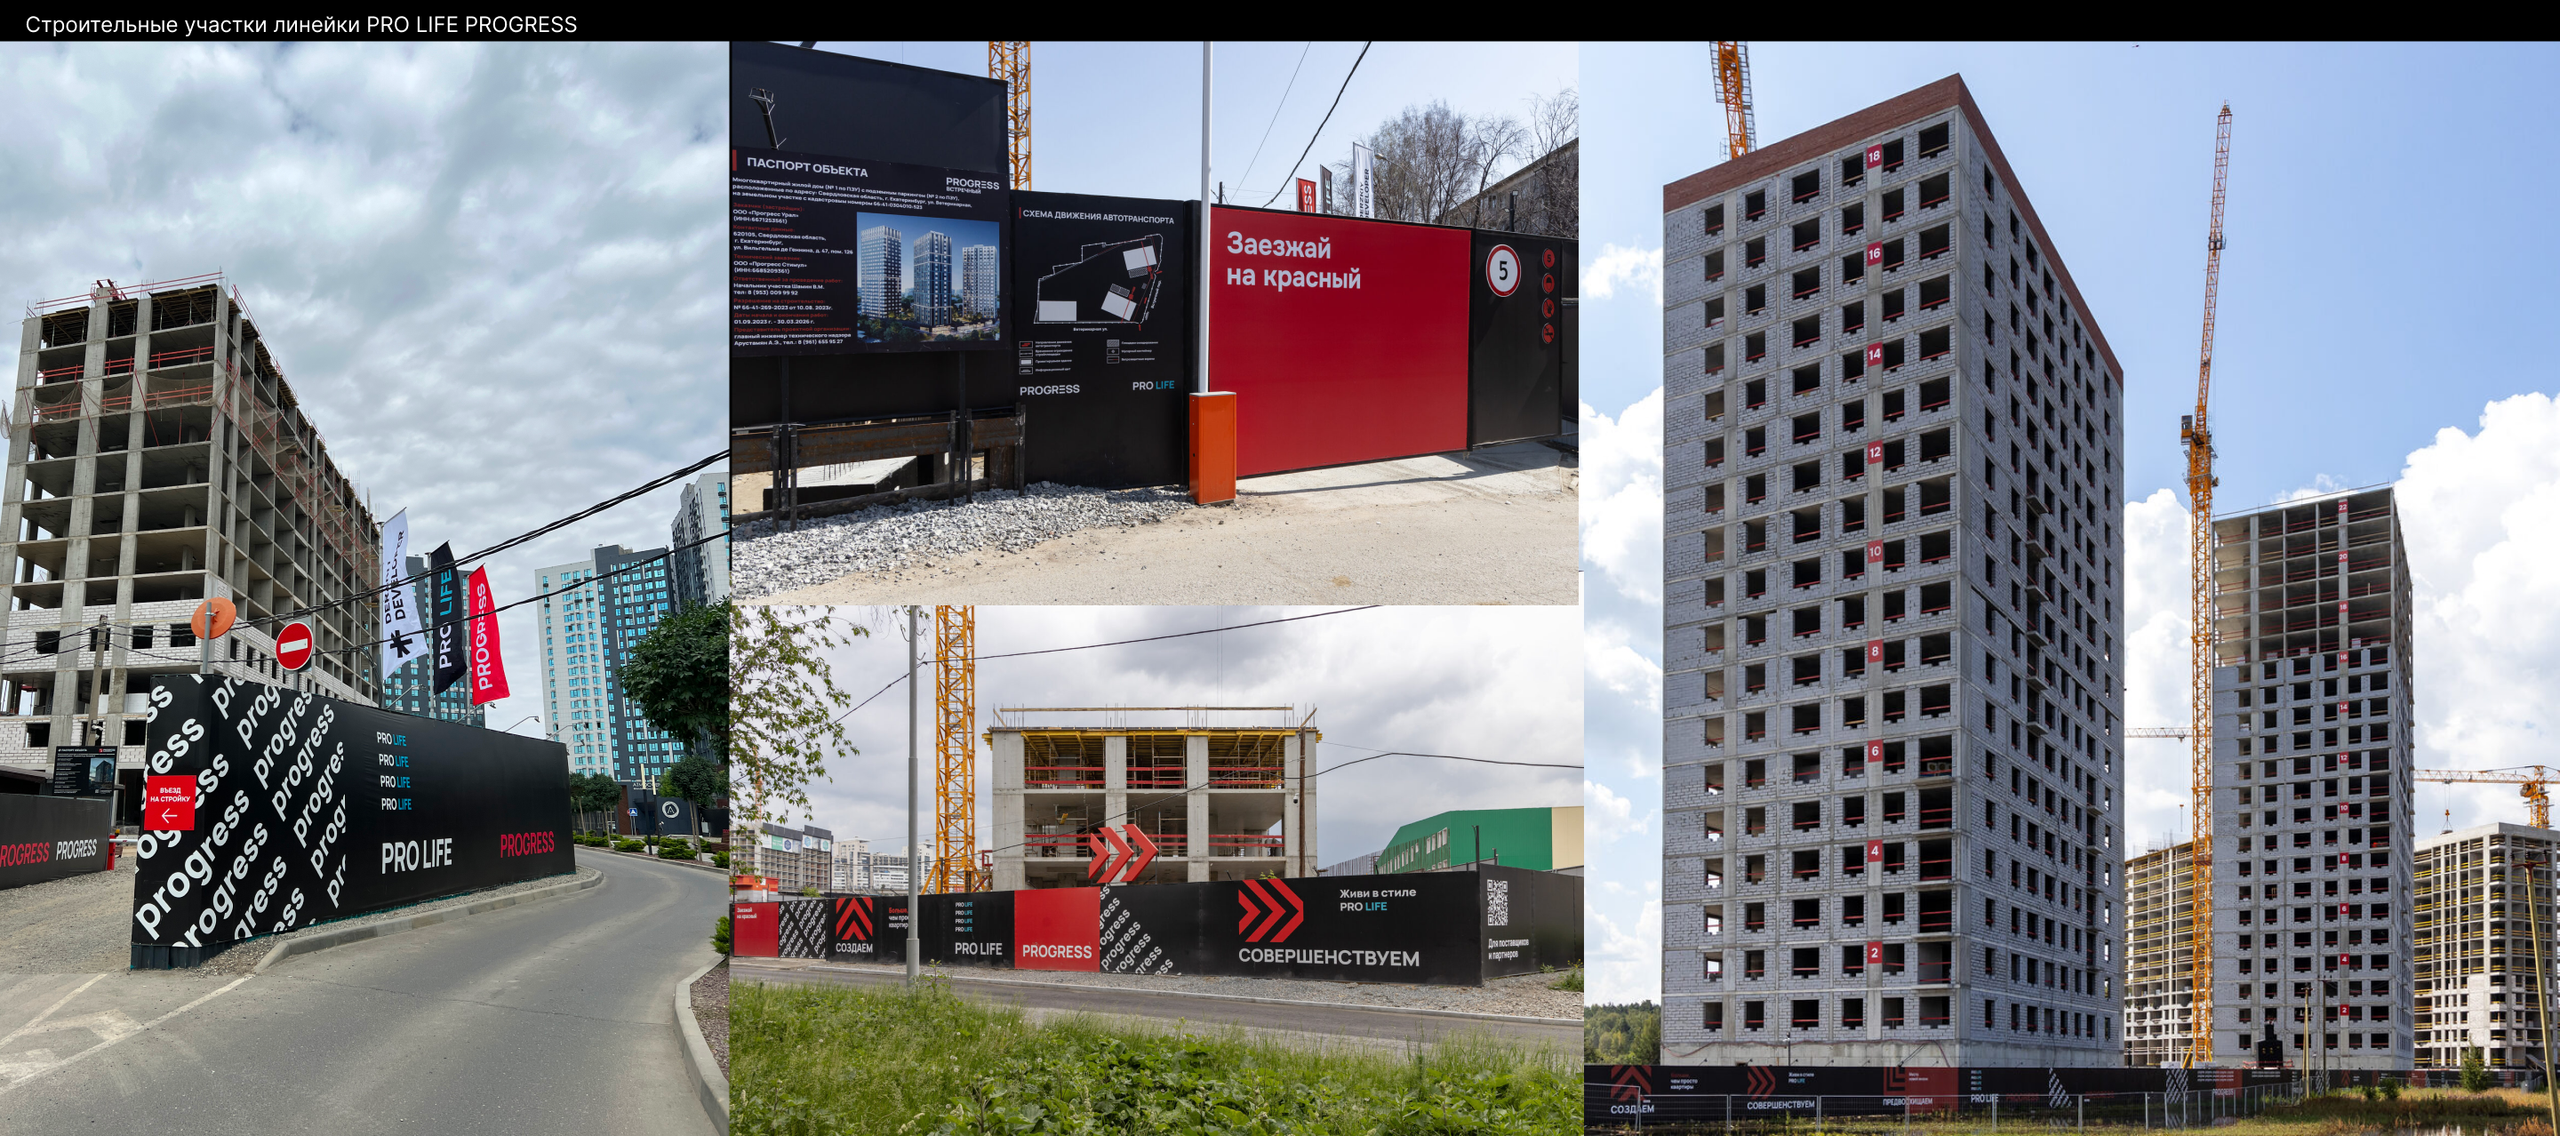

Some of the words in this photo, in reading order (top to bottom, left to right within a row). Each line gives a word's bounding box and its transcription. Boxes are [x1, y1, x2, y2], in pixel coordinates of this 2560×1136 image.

[1869, 150, 1880, 162] 18
[747, 157, 811, 172] ПАСПОРТ
[812, 163, 868, 178] ОБЪЕКТА
[732, 177, 791, 188] Многоквартирный
[946, 177, 1000, 190] PROGRESS
[818, 190, 859, 199] Свердловская
[946, 186, 981, 195] ВСТРЕЧНЫЙ
[748, 210, 781, 218] «Прогресс
[1023, 209, 1053, 219] СХЕМА
[1054, 210, 1101, 221] ДВИЖЕНИЯ
[1102, 213, 1174, 225] АВТОТРАНСПОРТА
[758, 232, 801, 240] Свердловская
[1227, 231, 1331, 259] Заезжай
[1869, 248, 1880, 259] 16
[1499, 261, 1508, 281] 5
[1227, 267, 1256, 286] на
[1263, 267, 1361, 292] красный
[1869, 349, 1881, 360] 14
[1020, 384, 1080, 396] PROGRESS
[1132, 381, 1153, 391] PRO
[1155, 380, 1175, 390] LIFE
[1870, 447, 1880, 458] 12
[1870, 546, 1881, 557] 10
[440, 569, 452, 616] LIFE
[1871, 646, 1879, 657] 8
[377, 731, 392, 745] PRO
[393, 733, 407, 747] LIFE
[1871, 746, 1879, 757] 6
[271, 704, 335, 822] progress
[379, 753, 394, 767] PRO
[395, 755, 409, 768] LIFE
[380, 775, 396, 788] PRO
[397, 776, 411, 789] LIFE
[160, 787, 182, 795] ВЪЕЗД
[160, 795, 191, 803] СТРОЙКУ
[381, 798, 397, 811] PRO
[398, 798, 412, 811] LIFE
[56, 839, 98, 861] PROGRESS
[500, 831, 555, 858] PROGRESS
[381, 841, 419, 875] PRO
[423, 838, 453, 869] LIFE
[1871, 846, 1879, 856] 4
[135, 790, 250, 940] progress
[1339, 888, 1370, 899] Живи
[1381, 888, 1417, 898] стиле
[1340, 901, 1364, 912] PRO
[1365, 901, 1387, 911] LIFE
[803, 902, 824, 938] progress
[835, 942, 873, 954] СОЗДАЕМ
[955, 942, 978, 955] PRO
[980, 942, 1003, 955] LIFE
[1101, 921, 1141, 971] progress
[1488, 938, 1498, 949] Для
[1499, 938, 1530, 948] поставщиков
[1022, 944, 1092, 960] PROGRESS
[1239, 947, 1420, 967] СОВЕРШЕНСТВУЕМ
[1492, 950, 1519, 962] партнеров
[1871, 948, 1878, 958] 2
[1971, 1093, 1984, 1103] PRO
[1747, 1100, 1815, 1110] СОВЕРШЕНСТВУЕМ
